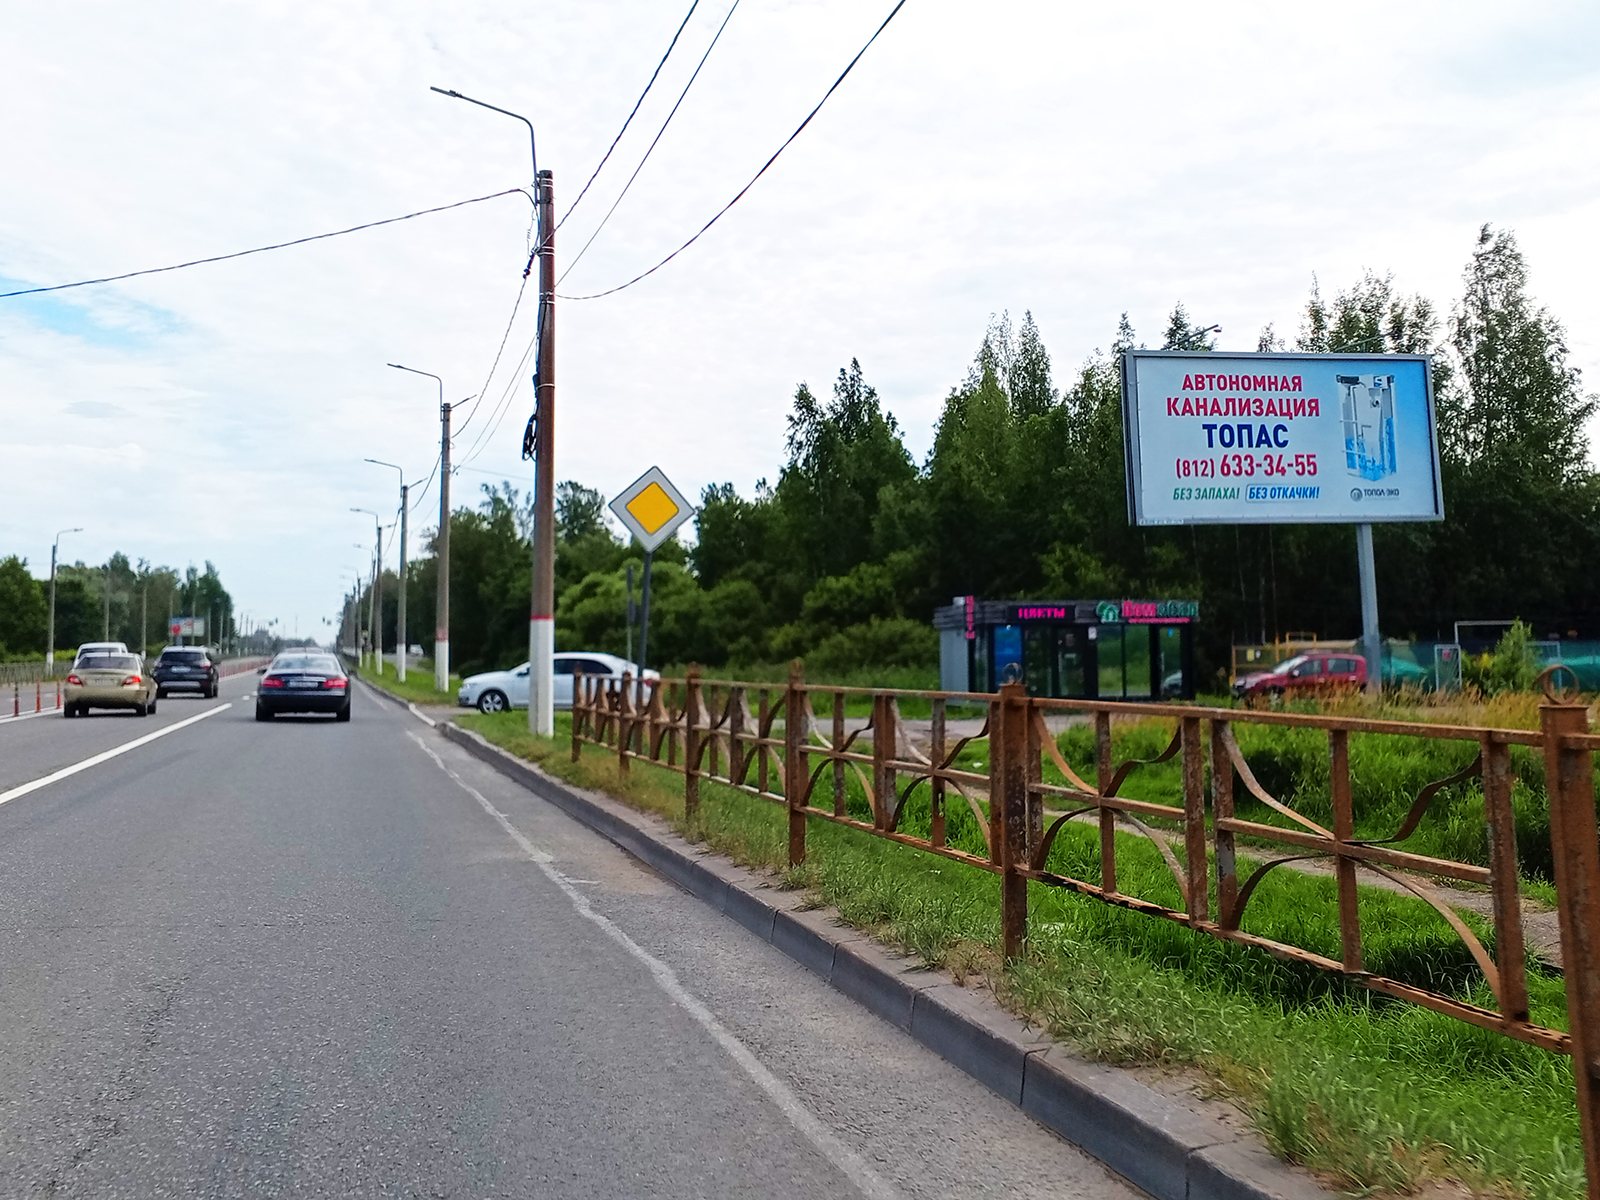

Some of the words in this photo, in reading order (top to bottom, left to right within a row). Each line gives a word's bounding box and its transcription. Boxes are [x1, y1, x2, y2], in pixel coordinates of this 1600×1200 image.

[1181, 374, 1302, 392] АВТОНОМНАЯ
[1166, 397, 1320, 420] КАНАЛИЗАЦИЯ
[1202, 423, 1290, 448] ТОПАС
[1176, 458, 1215, 479] (812)
[1220, 454, 1318, 477] 633-34-55
[1172, 487, 1193, 500] БЕЗ
[1195, 487, 1240, 500] ЗАПАХА!
[1248, 486, 1269, 500] БЕЗ
[1270, 486, 1320, 500] ОТКАЧКИ!
[1017, 607, 1066, 620] ЦВЕТЫ
